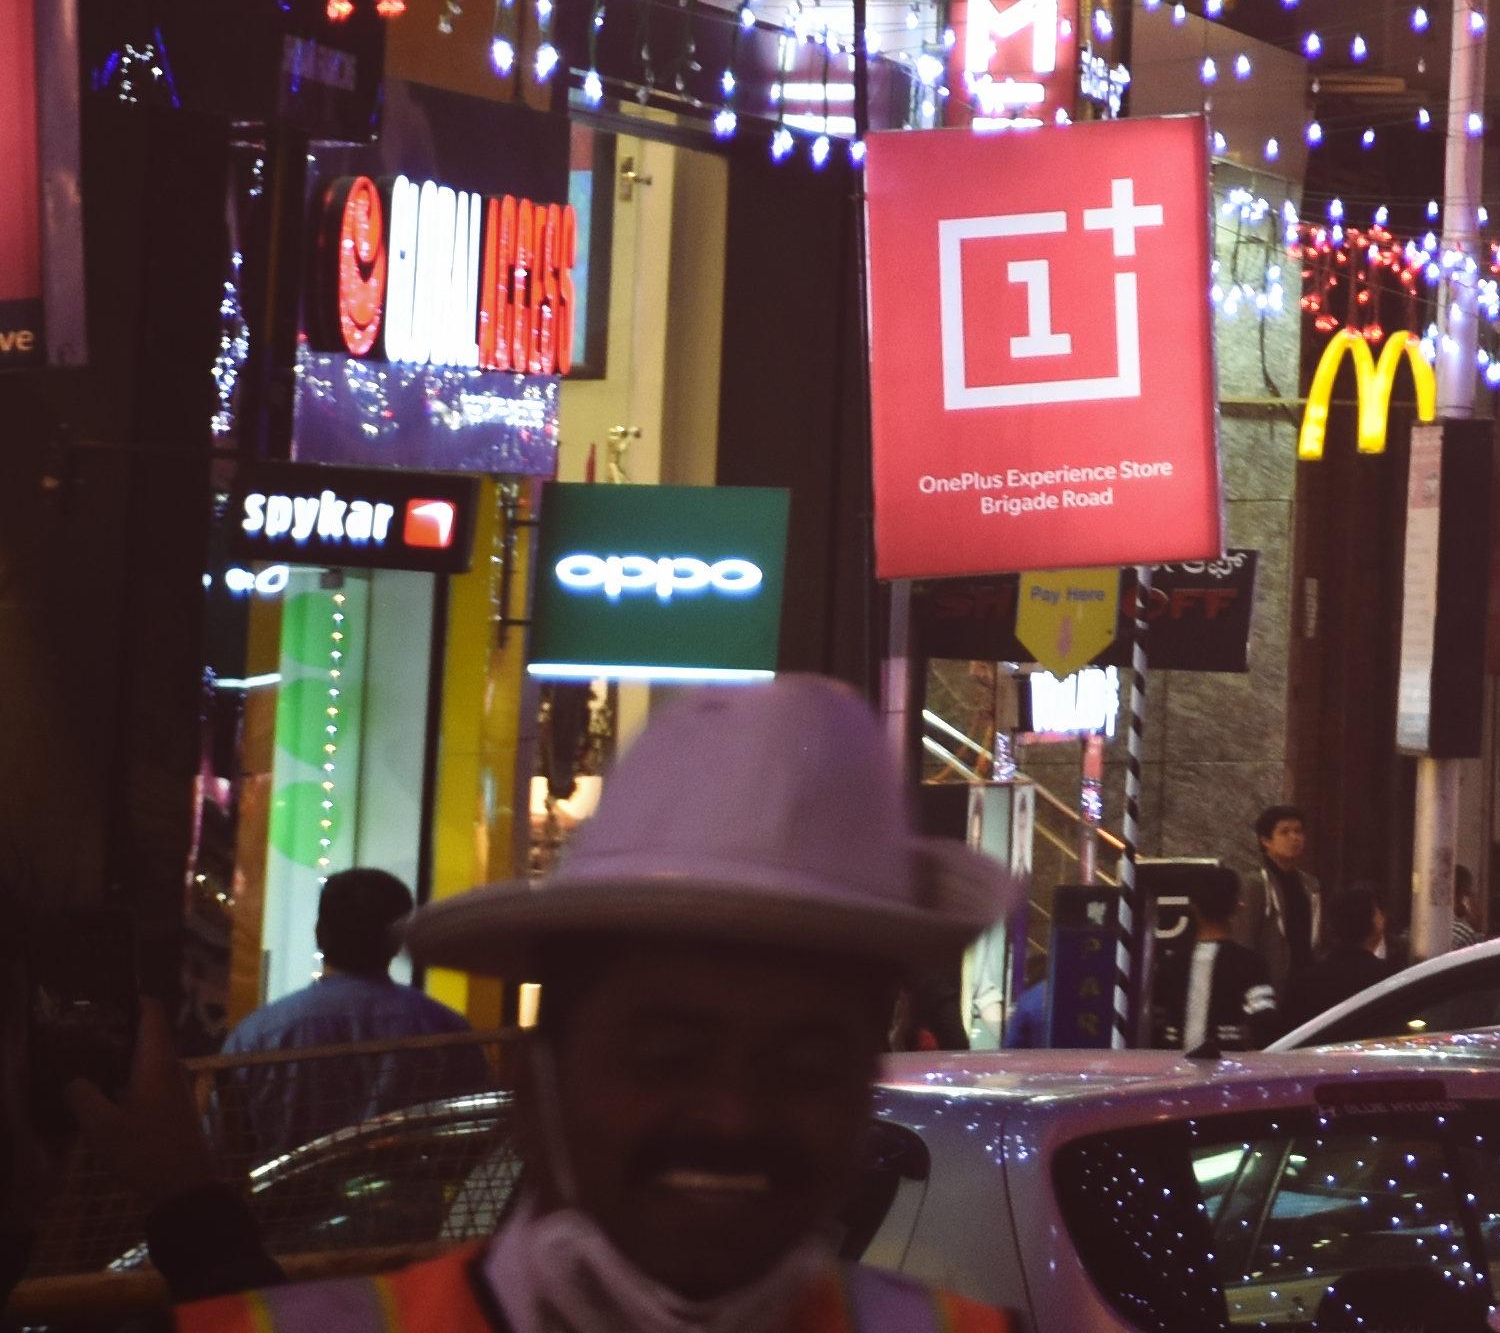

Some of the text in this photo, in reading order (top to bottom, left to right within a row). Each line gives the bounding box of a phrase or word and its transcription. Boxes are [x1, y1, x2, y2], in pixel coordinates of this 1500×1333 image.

[919, 459, 1174, 494] OnePlus Experience Store
[241, 490, 396, 541] spykar
[980, 487, 1115, 517] Brigade Road
[555, 553, 764, 597] oppo
